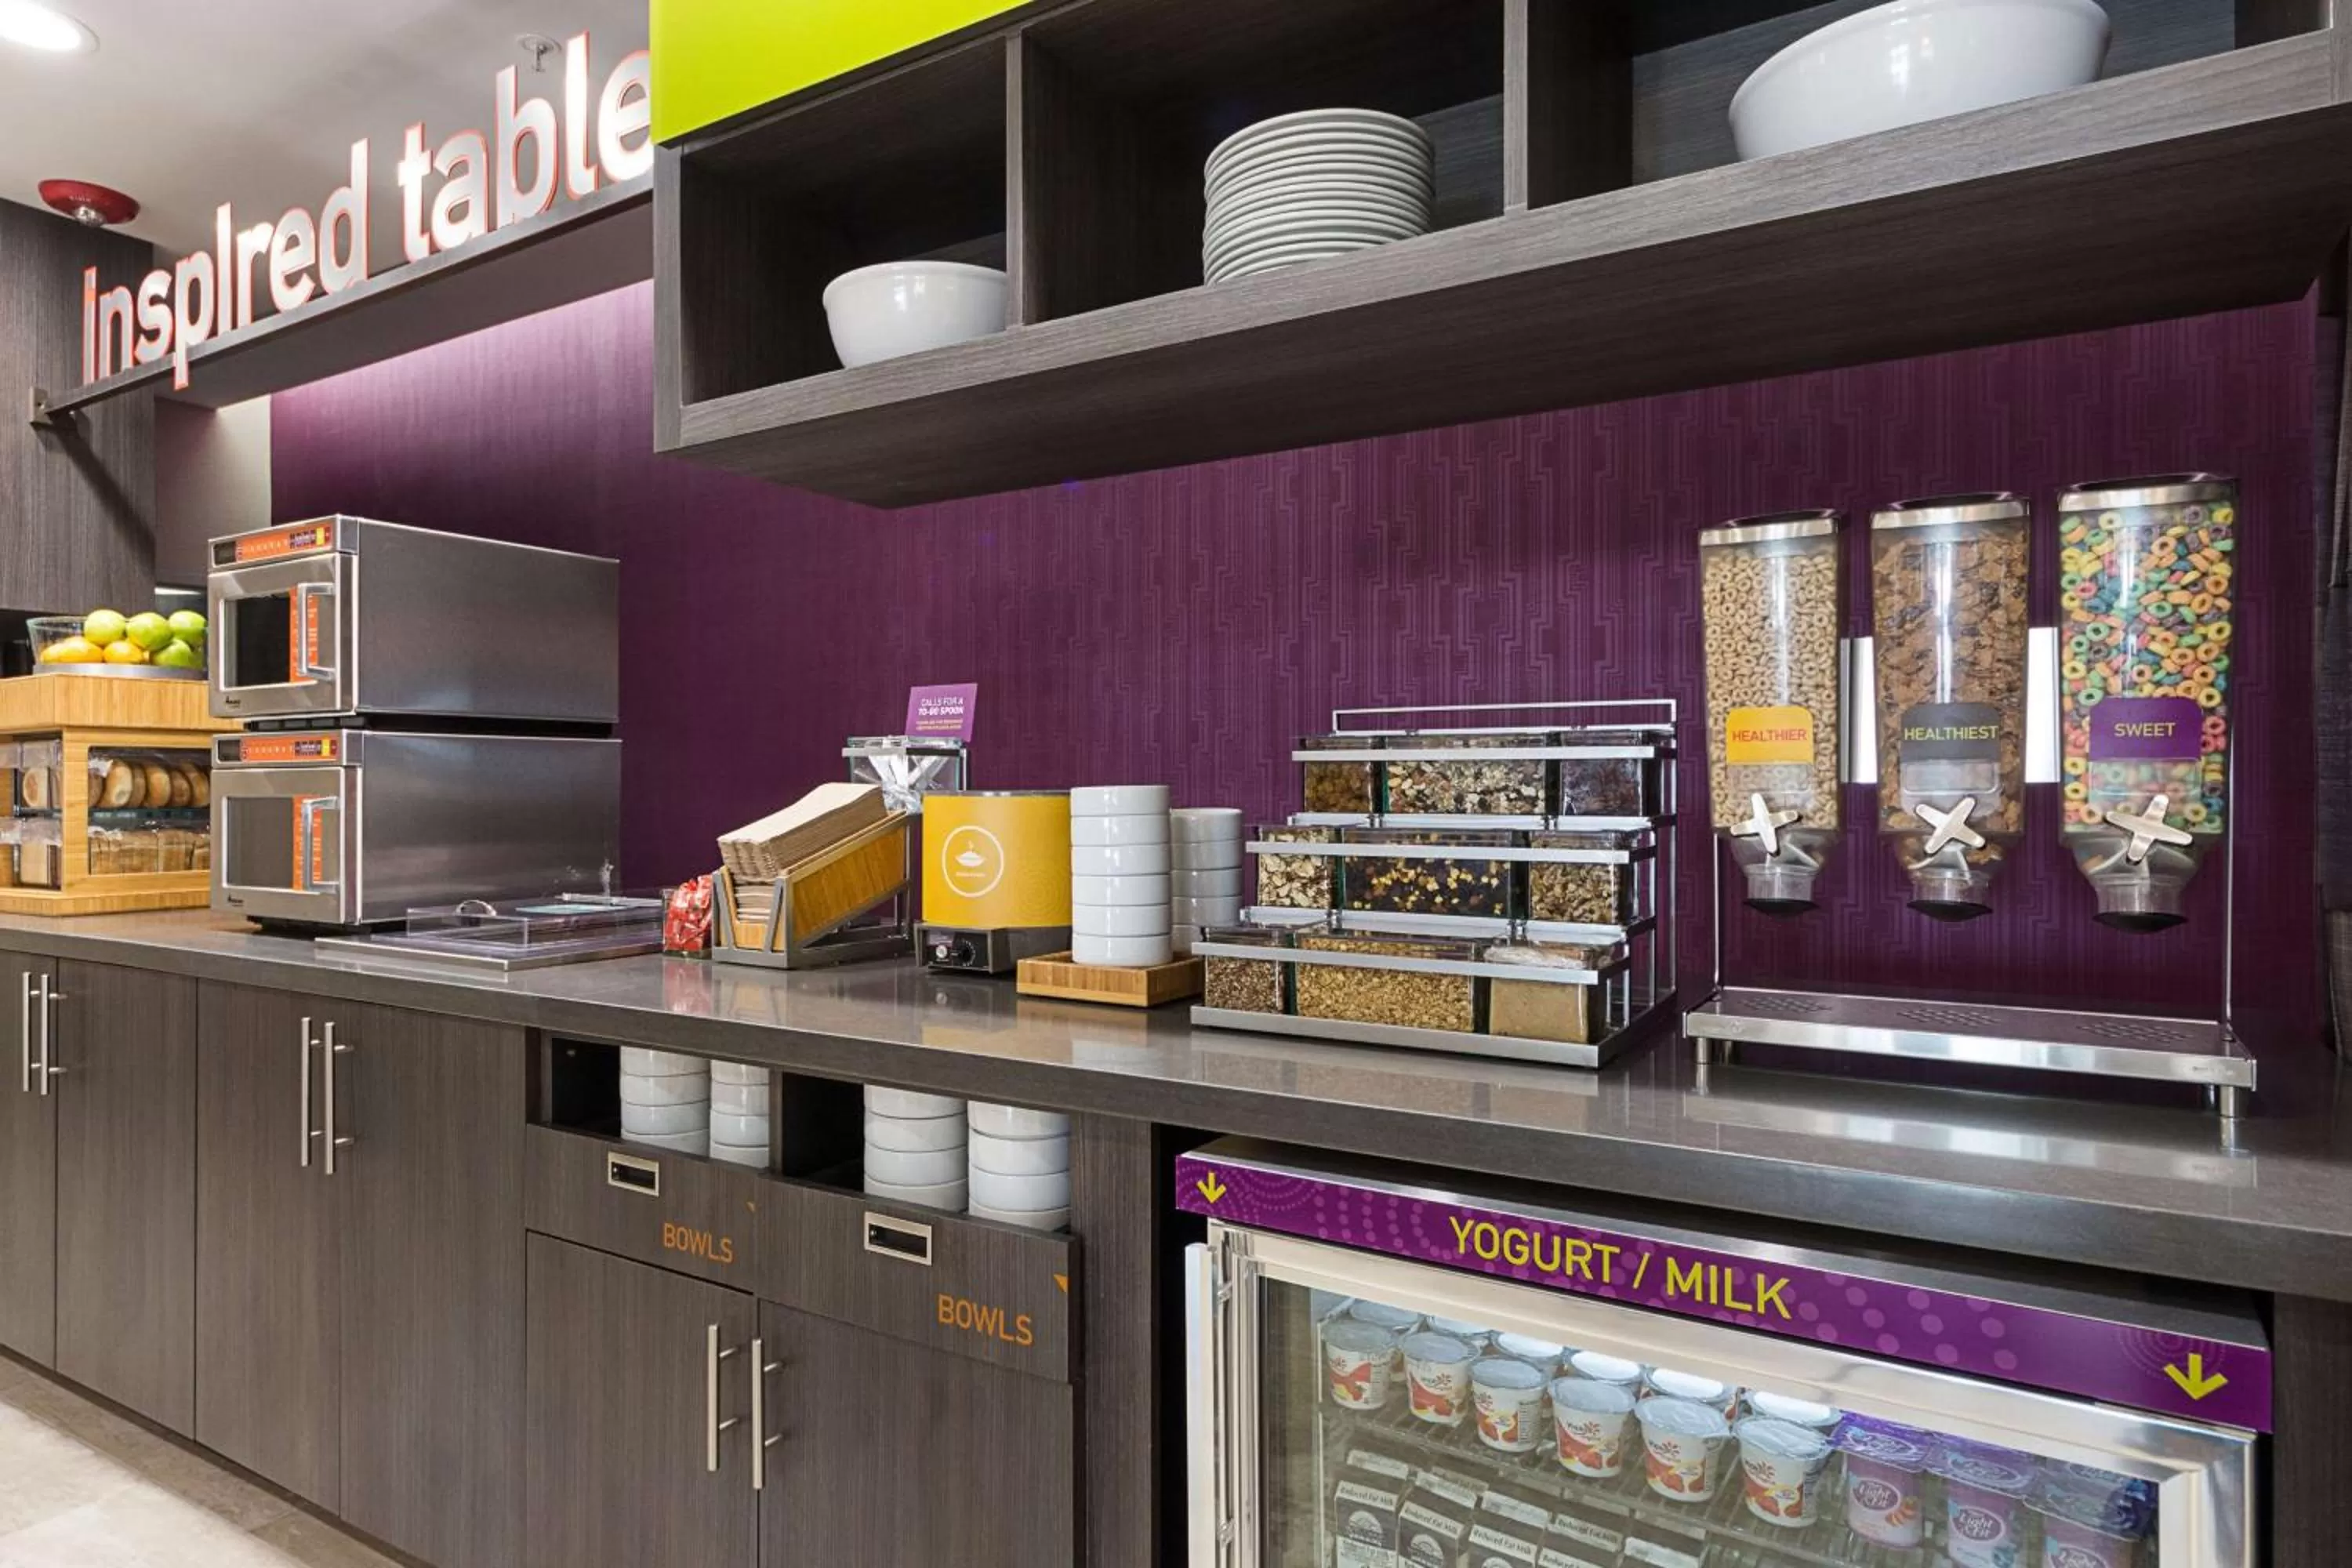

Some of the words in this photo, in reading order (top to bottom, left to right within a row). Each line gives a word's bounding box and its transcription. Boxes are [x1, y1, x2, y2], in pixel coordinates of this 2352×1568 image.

[397, 31, 653, 263] table
[1732, 728, 1808, 743] HEALTHIER
[1904, 725, 1999, 742] HEALTHIEST
[2114, 721, 2176, 738] SWEET
[662, 1223, 734, 1264] BOWLS
[1449, 1216, 1621, 1283] YOGURT
[1632, 1253, 1650, 1290] /
[1666, 1257, 1792, 1320] MILK
[938, 1294, 1034, 1346] BOWLS
[1959, 1512, 1993, 1530] Light
